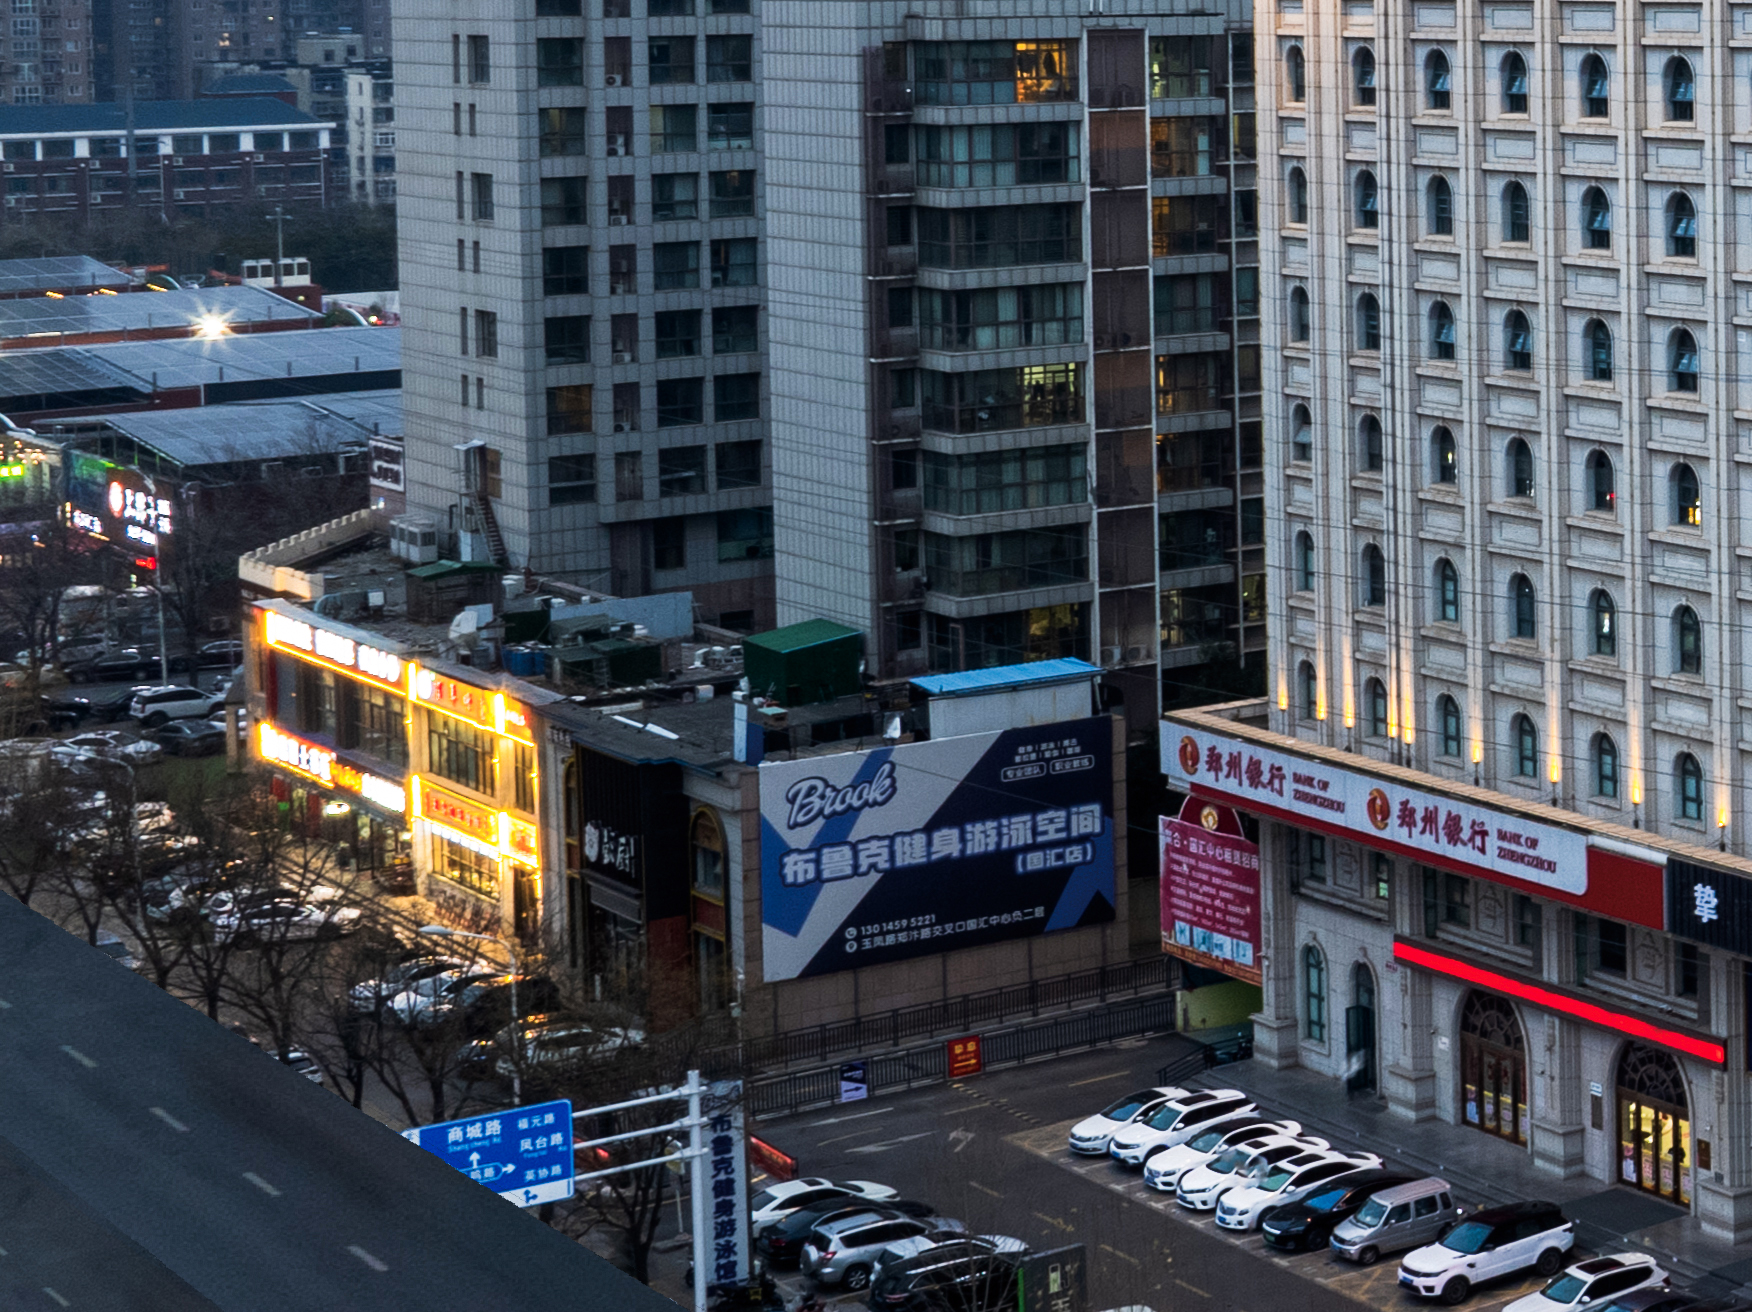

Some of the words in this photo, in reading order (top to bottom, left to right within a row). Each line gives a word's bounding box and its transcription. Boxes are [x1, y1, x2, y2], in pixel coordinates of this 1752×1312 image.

[1205, 745, 1287, 797] 郑州银行
[787, 761, 897, 829] Brook
[782, 803, 1103, 885] 布鲁克健身游泳空间
[1397, 798, 1490, 855] 郑州银行
[1496, 828, 1524, 846] BANK
[1525, 835, 1540, 850] OF
[1496, 845, 1557, 874] ZHENGZHOU
[861, 924, 880, 936] 130
[882, 918, 908, 932] 1459
[910, 914, 936, 927] 5221
[447, 1119, 502, 1144] 商城路
[520, 1132, 564, 1152] 凤台路
[711, 1114, 738, 1282] 布鲁克健身游泳馆
